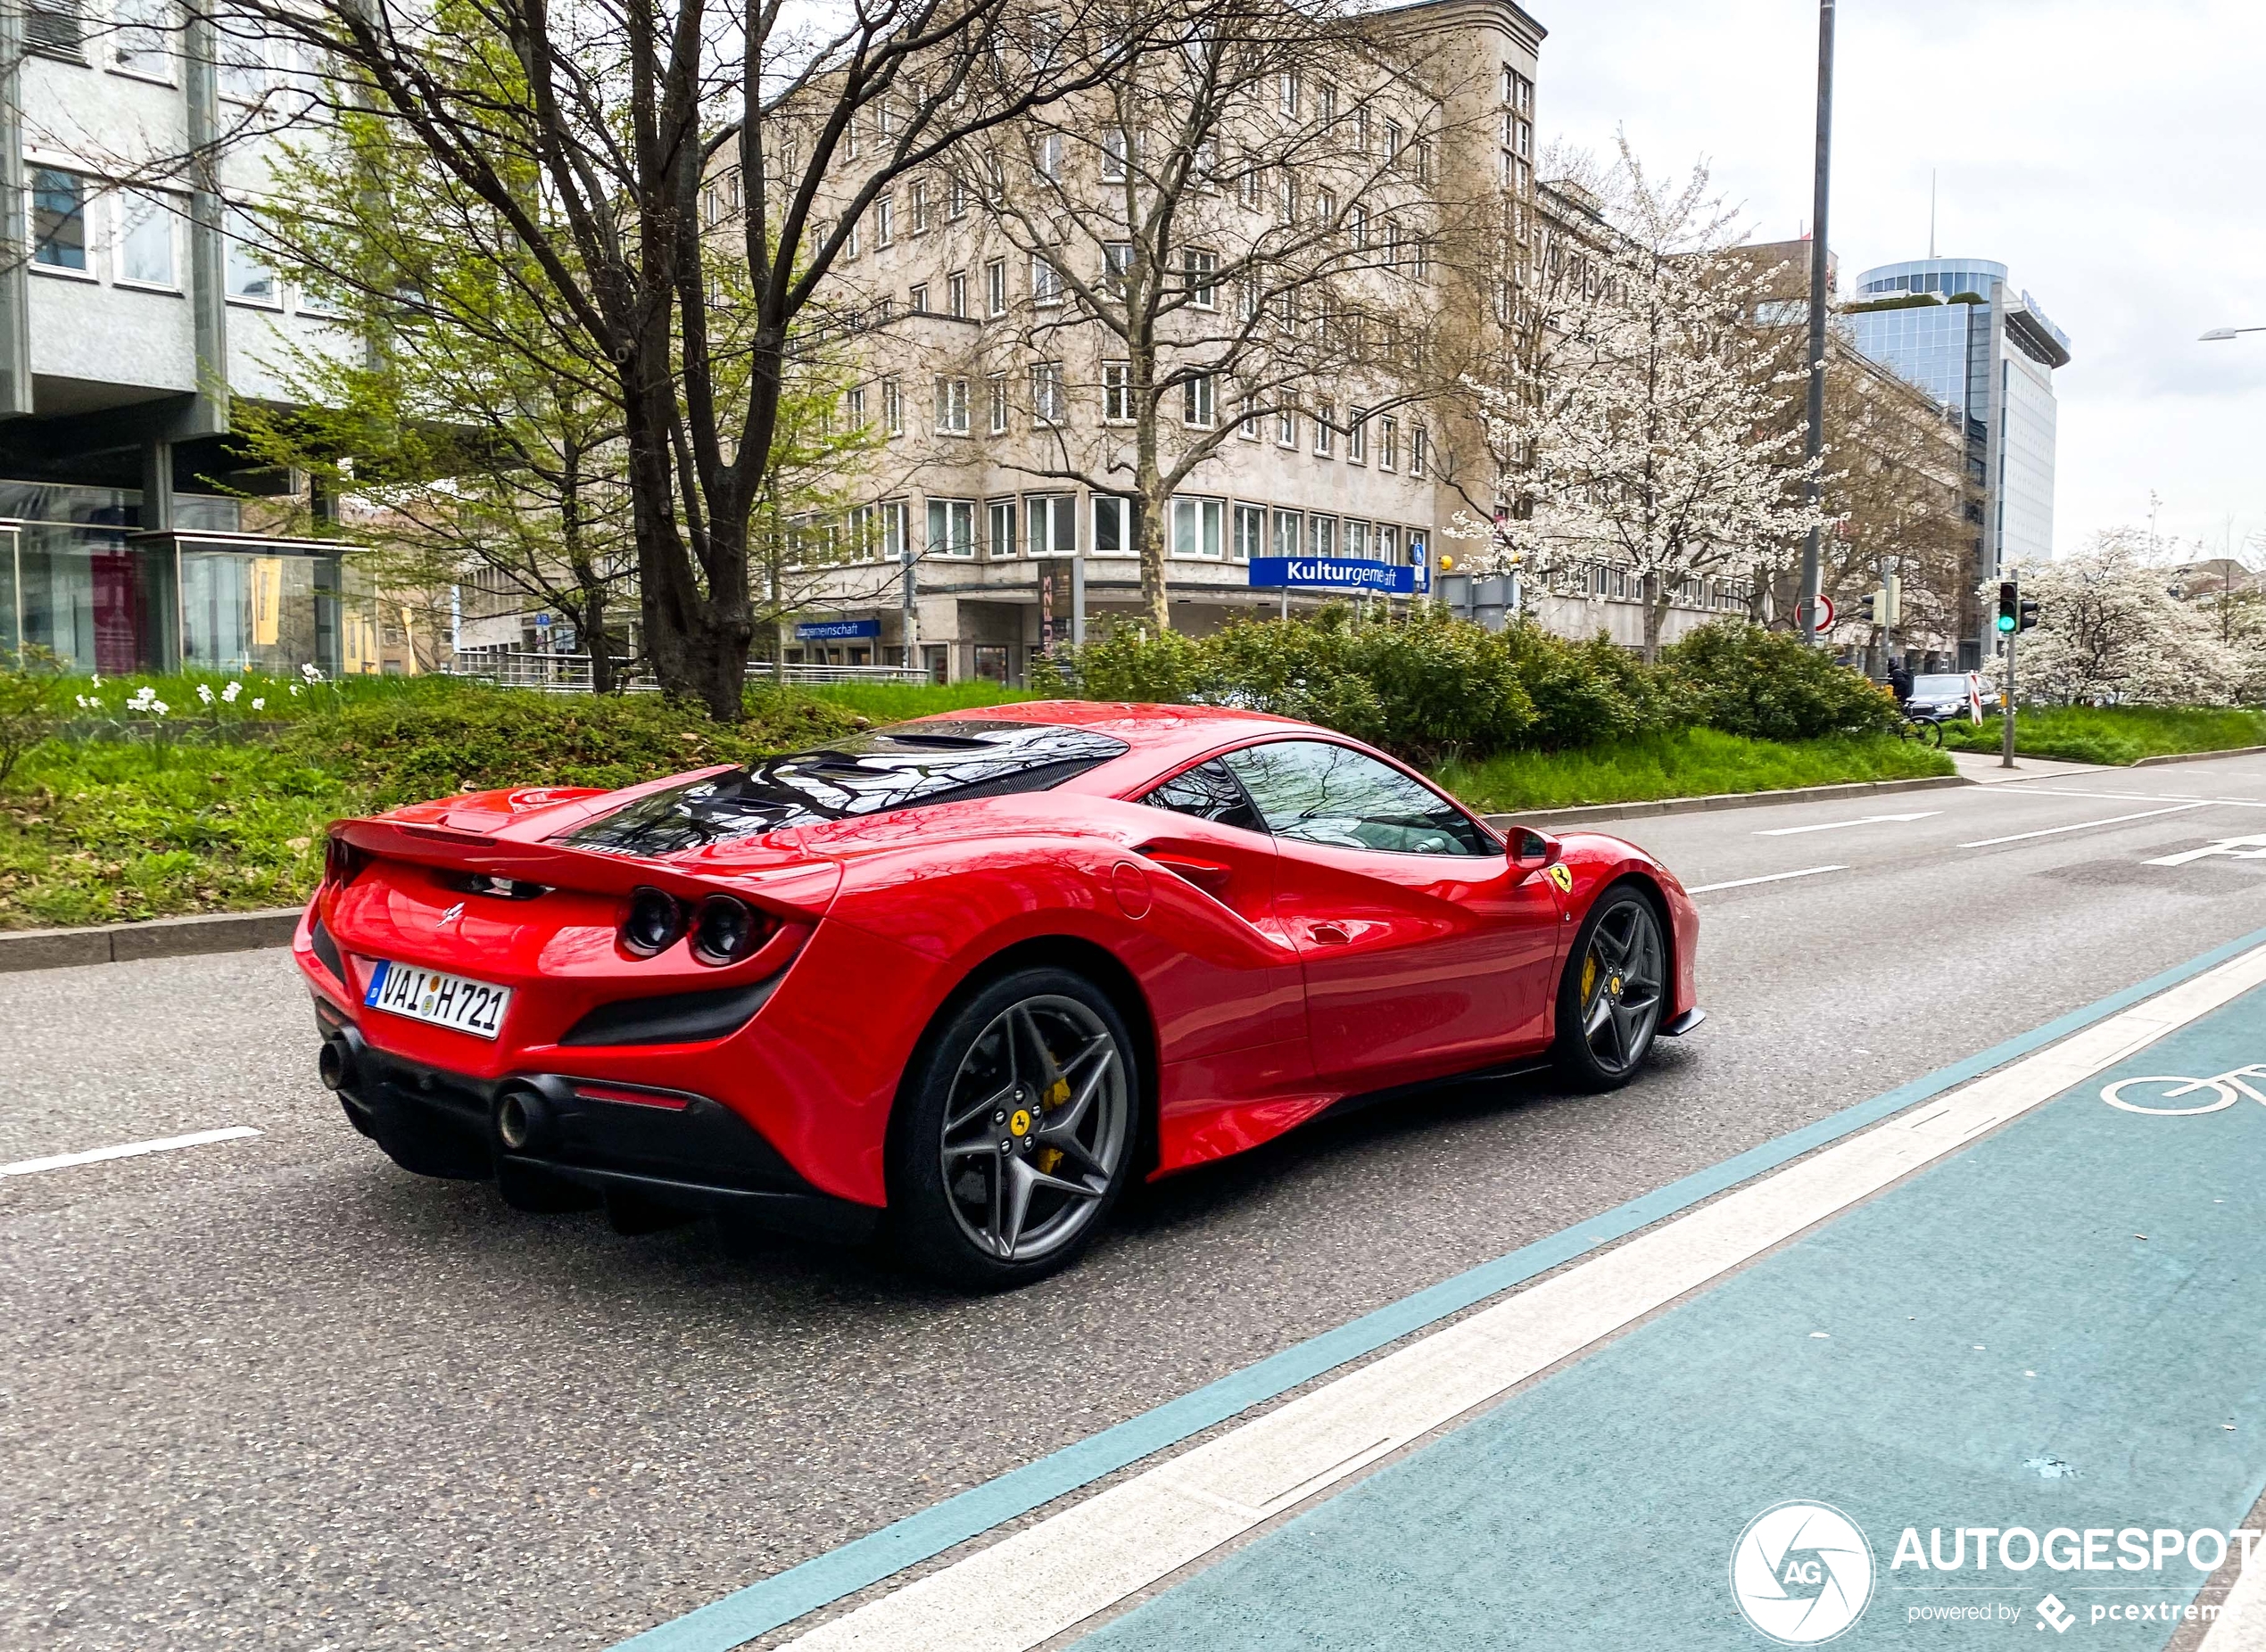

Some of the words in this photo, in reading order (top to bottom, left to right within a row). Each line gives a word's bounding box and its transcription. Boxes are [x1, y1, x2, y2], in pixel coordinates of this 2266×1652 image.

[384, 966, 426, 1011] VAI
[434, 979, 458, 1019] H
[456, 983, 504, 1031] 721
